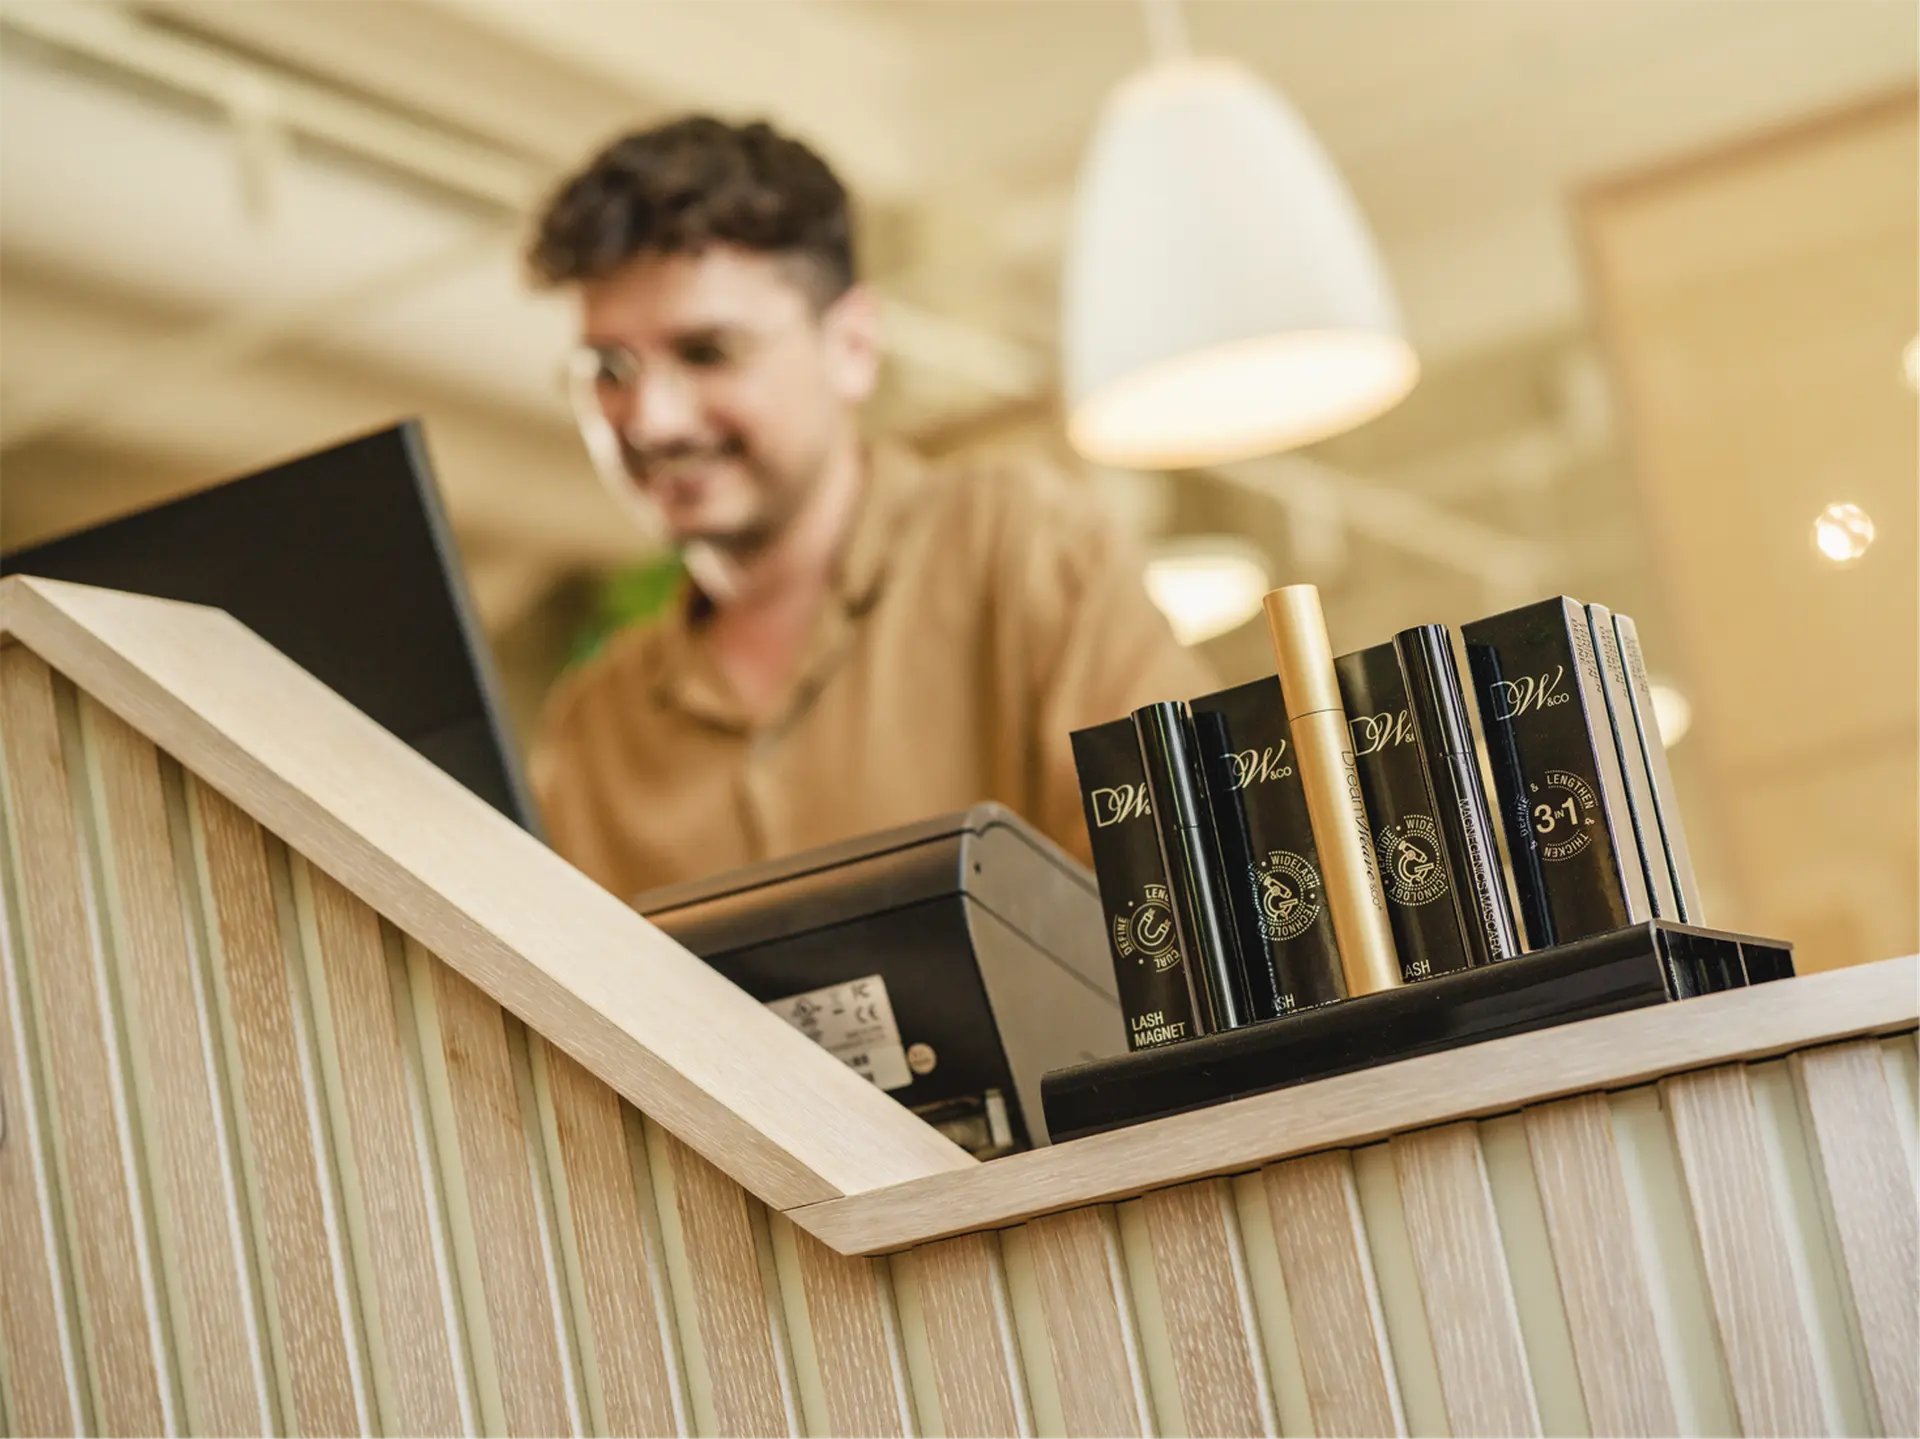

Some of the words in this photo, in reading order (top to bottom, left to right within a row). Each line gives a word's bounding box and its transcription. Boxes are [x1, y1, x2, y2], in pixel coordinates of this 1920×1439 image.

[1546, 774, 1595, 810] LENGTHEN
[1534, 804, 1555, 833] 3
[1554, 809, 1565, 819] IN
[1561, 797, 1578, 825] 1
[1405, 819, 1437, 837] WIDEL
[1544, 833, 1589, 858] THICKEN
[1270, 855, 1317, 889] WIDELASH
[1117, 917, 1132, 956] DEFINE
[1153, 949, 1179, 968] CURL
[1404, 959, 1431, 979] ASH
[1131, 1010, 1164, 1031] LASH
[1134, 1022, 1185, 1047] MAGNET
